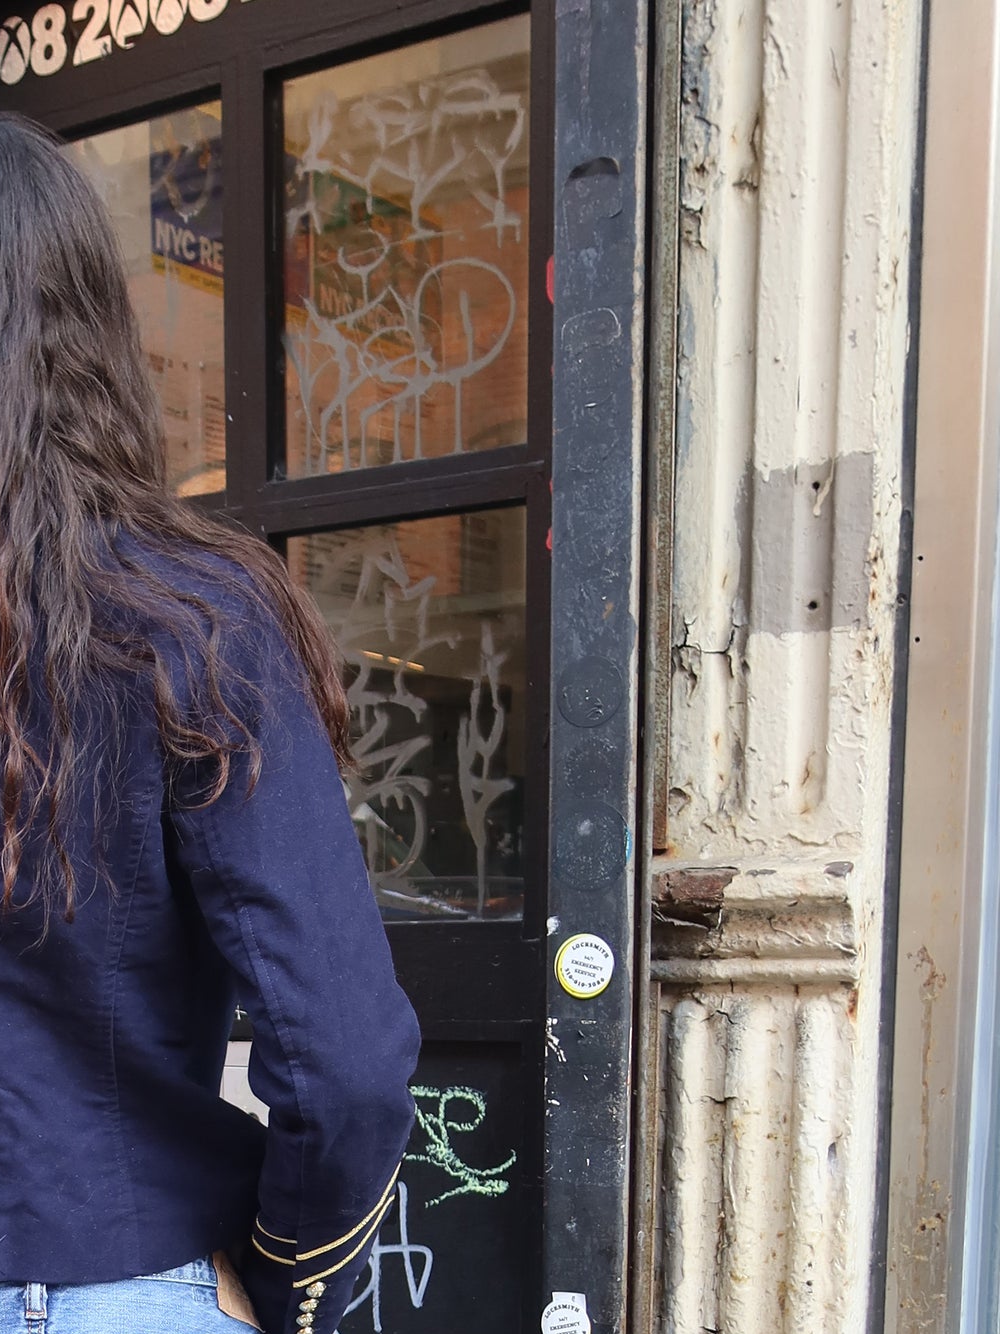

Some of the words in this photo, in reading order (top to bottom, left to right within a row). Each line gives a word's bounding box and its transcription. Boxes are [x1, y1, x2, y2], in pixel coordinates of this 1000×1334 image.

[155, 217, 197, 261] NYC
[572, 942, 609, 959] LOCKSMITH
[571, 960, 603, 971] EMERGENCY
[574, 969, 597, 978] SERVICE
[544, 1303, 580, 1319] LOCKSMITH
[549, 1321, 580, 1331] EMERGENCY
